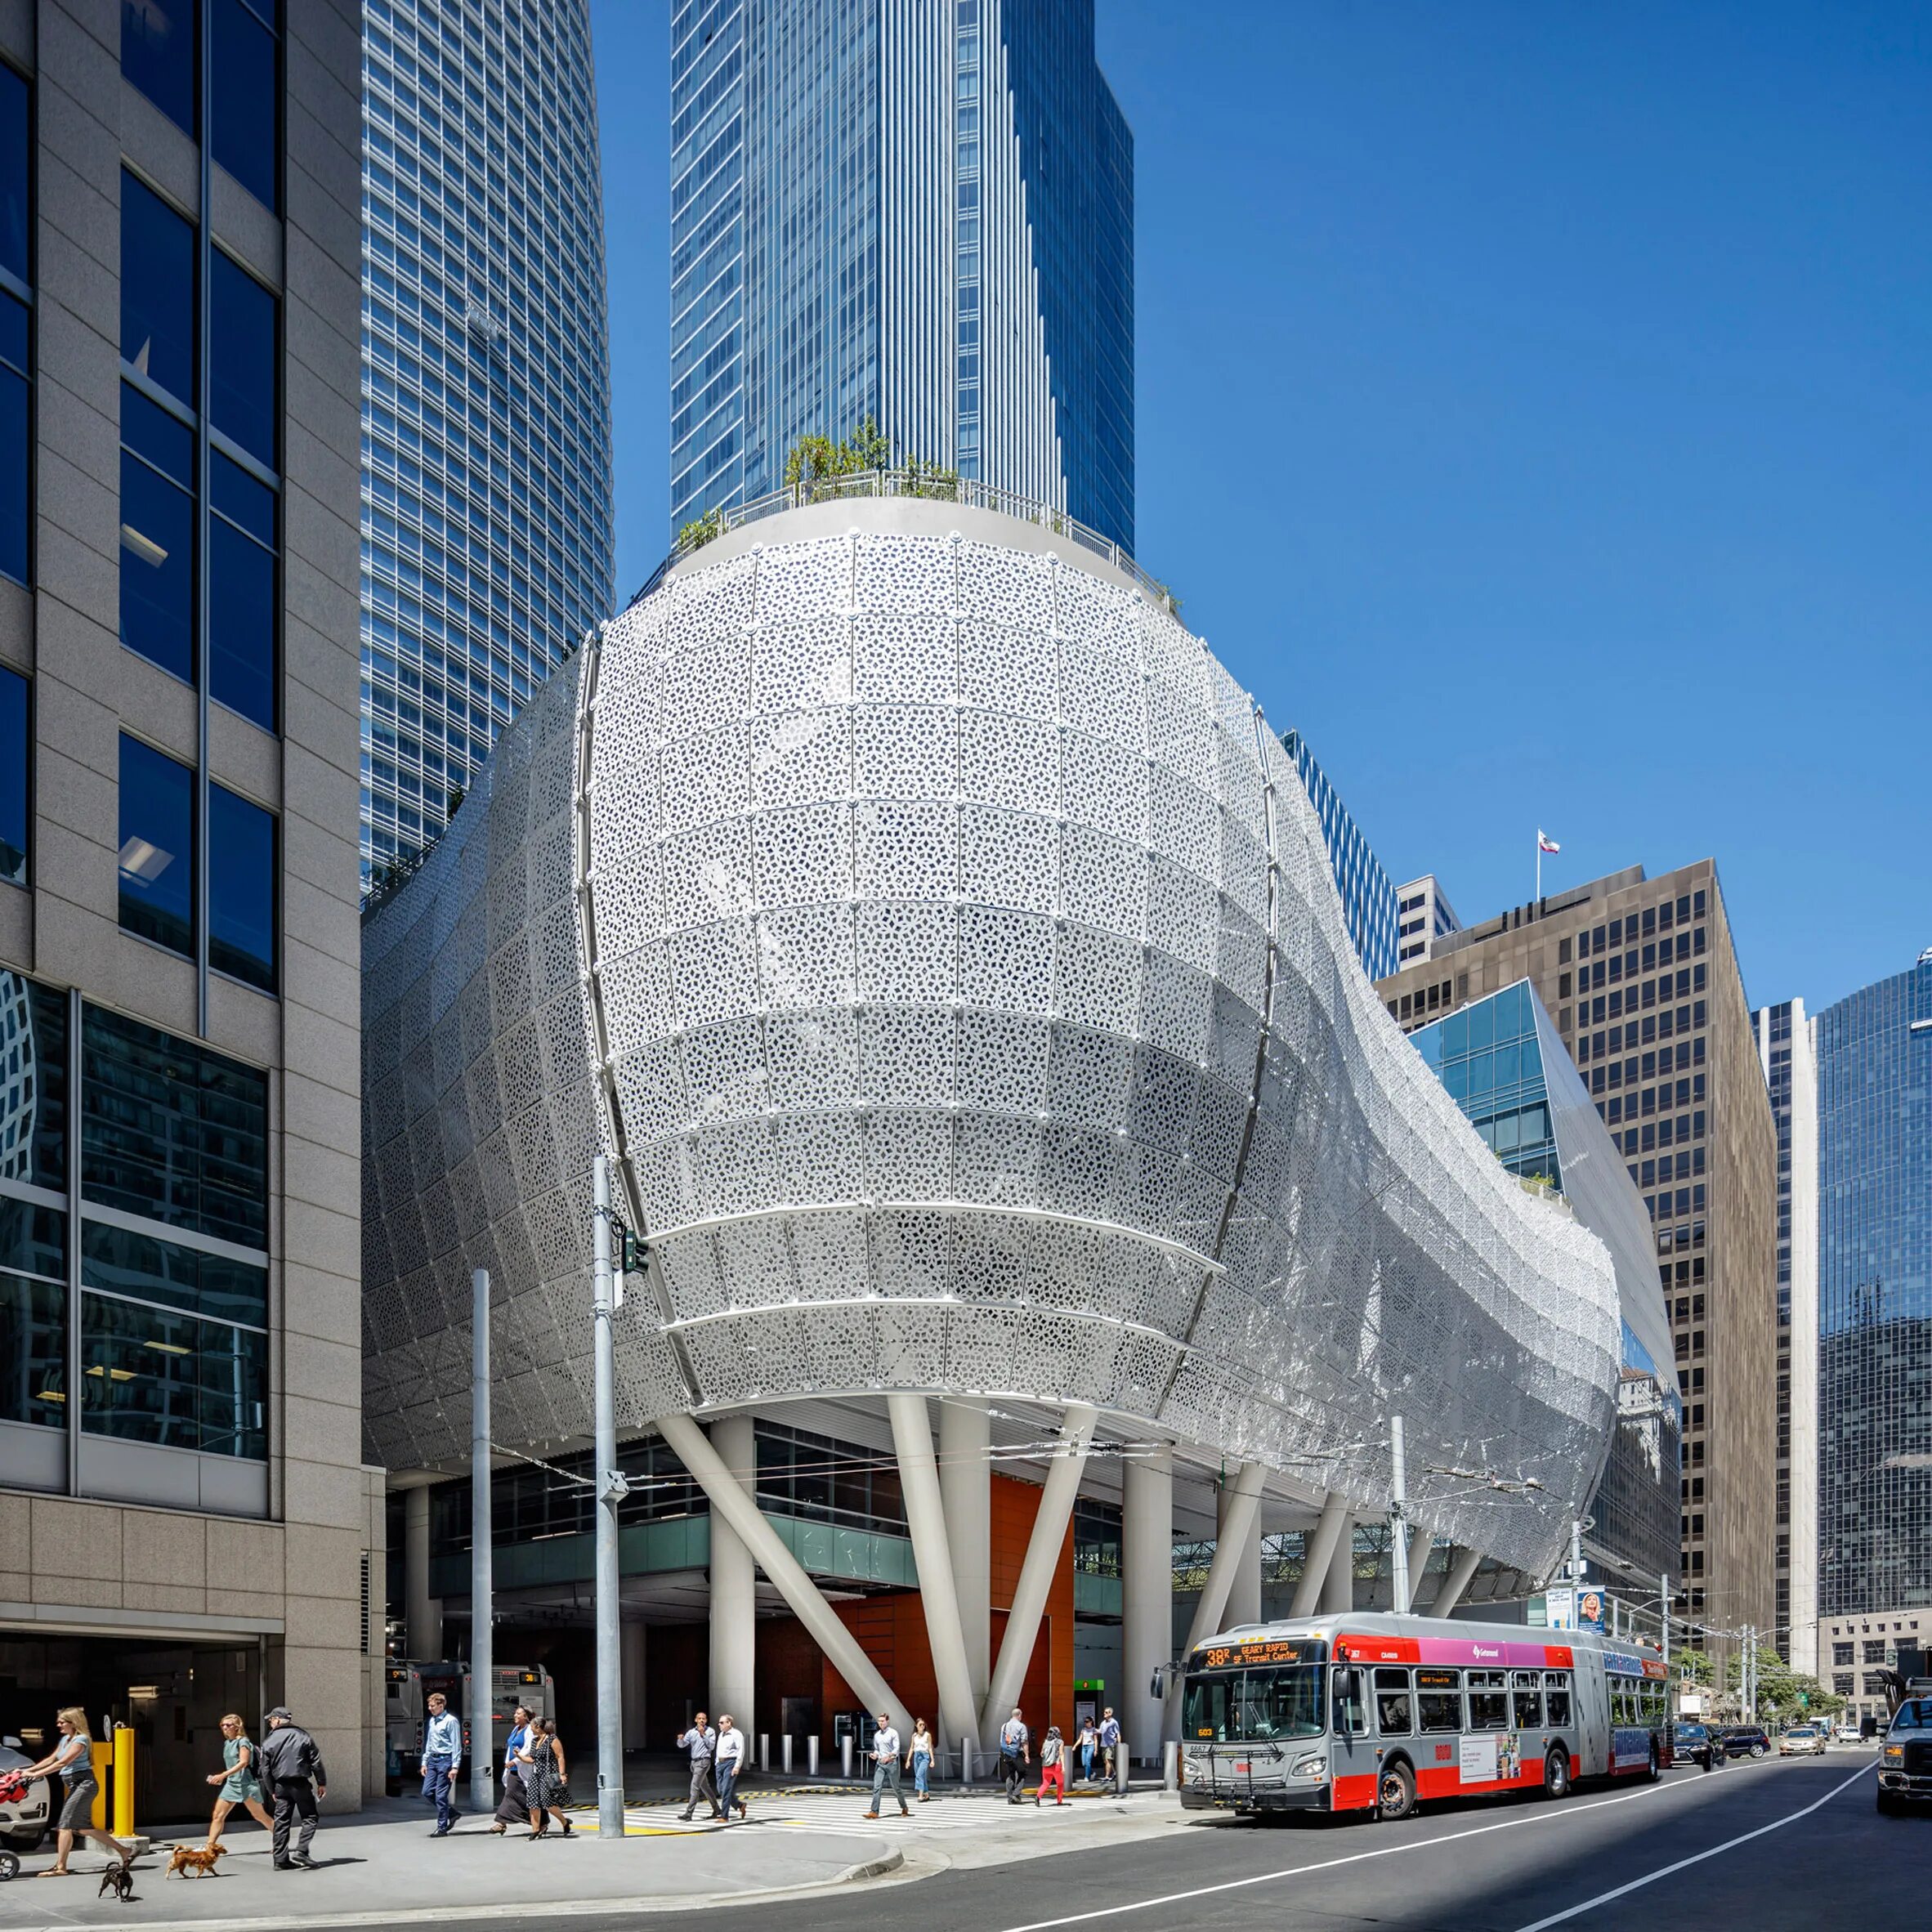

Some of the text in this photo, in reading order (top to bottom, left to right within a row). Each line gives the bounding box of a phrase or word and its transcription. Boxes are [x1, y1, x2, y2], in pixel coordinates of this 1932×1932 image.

[1241, 1642, 1289, 1655] GEARY RAPID
[1233, 1651, 1299, 1664] SF Transit Center
